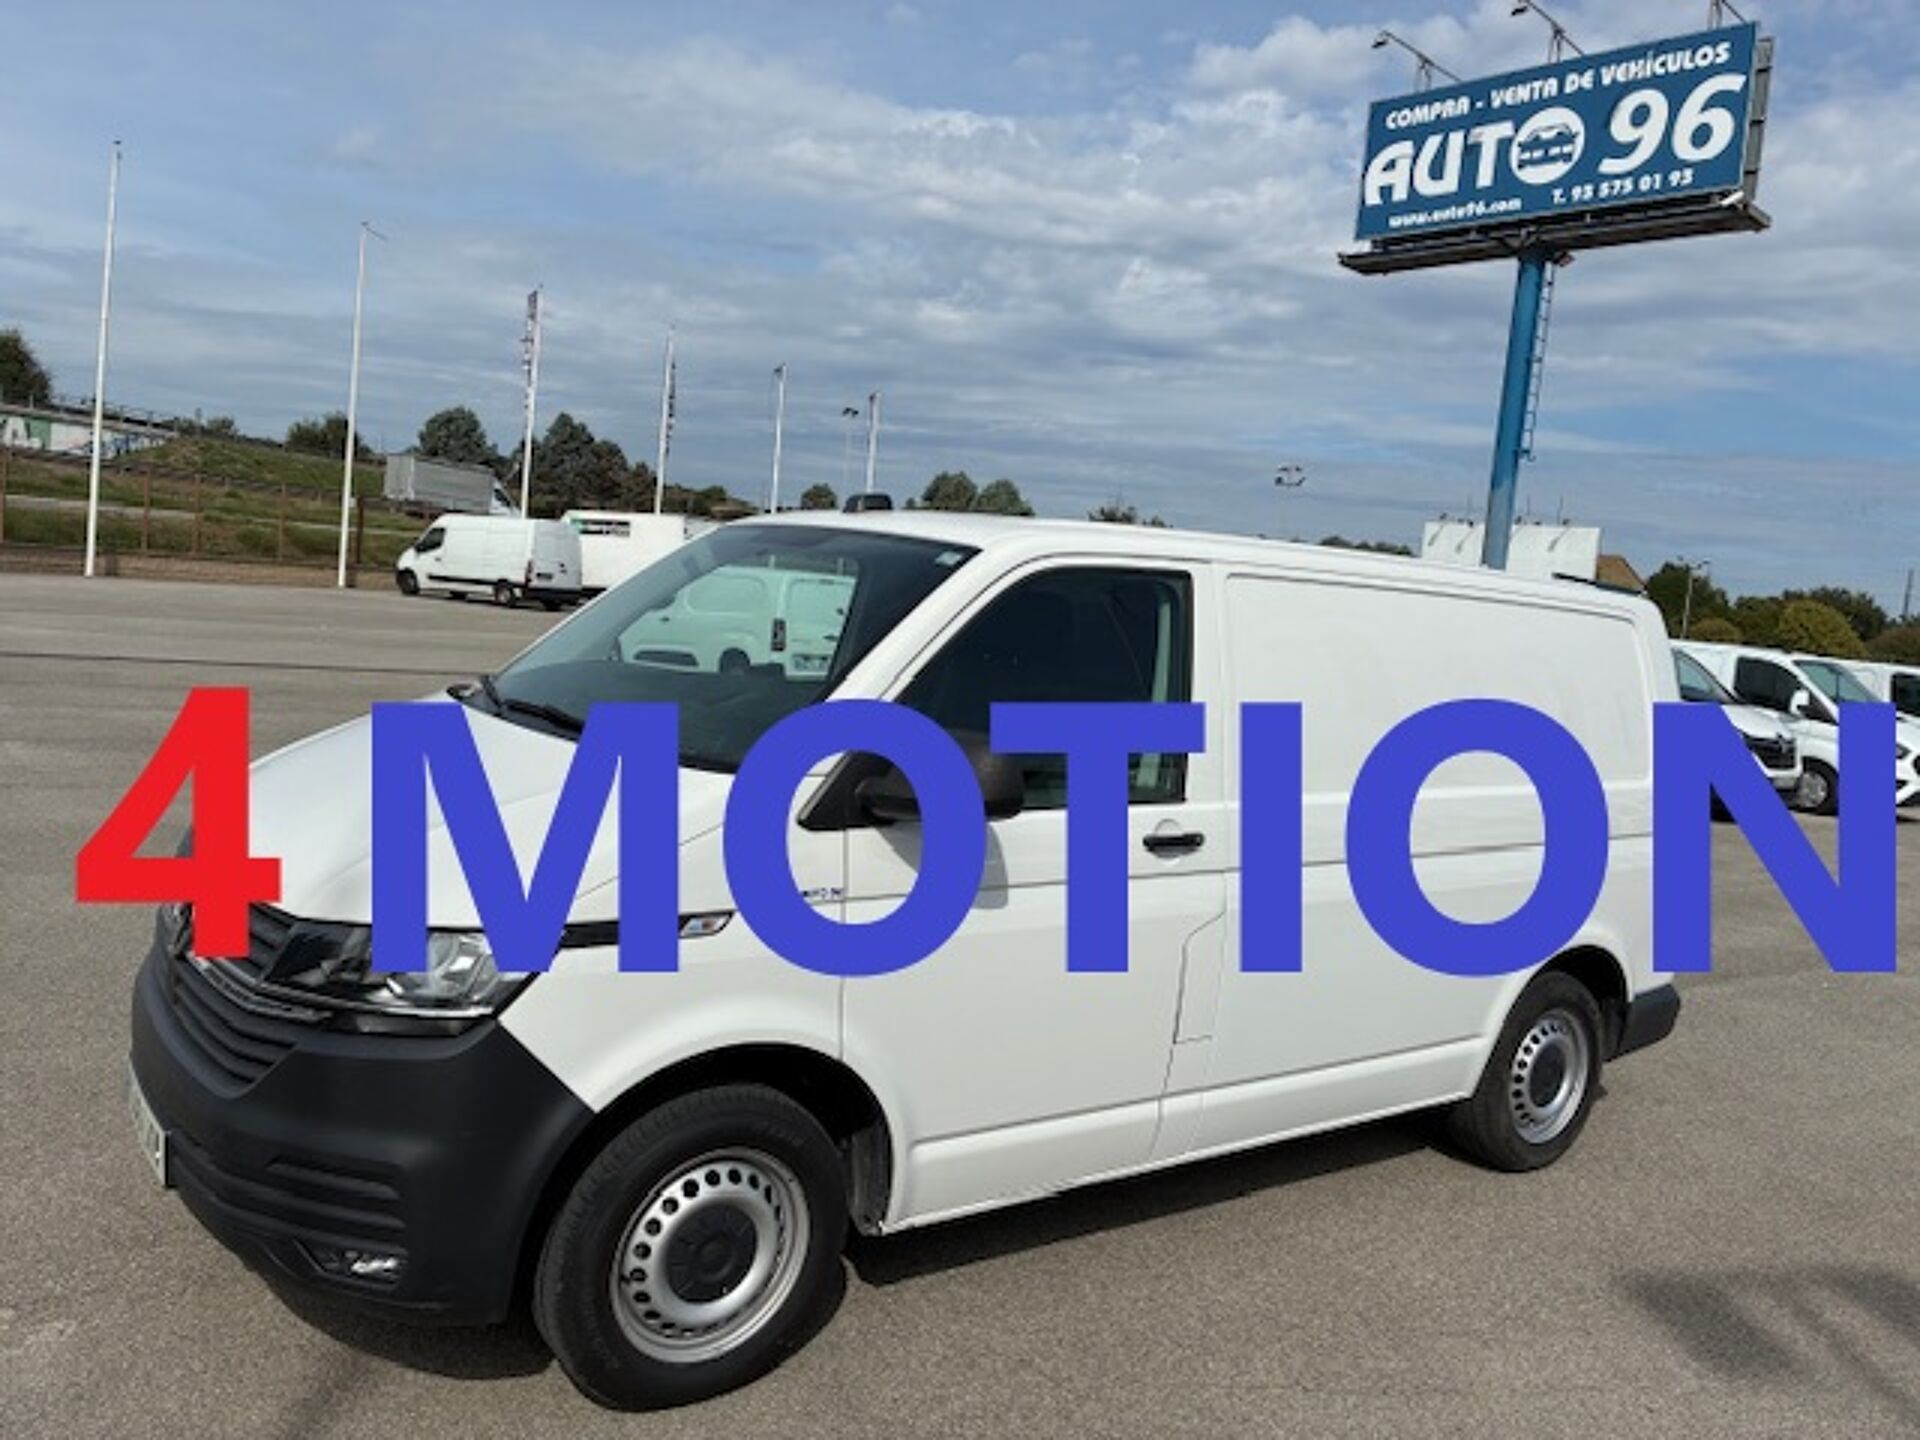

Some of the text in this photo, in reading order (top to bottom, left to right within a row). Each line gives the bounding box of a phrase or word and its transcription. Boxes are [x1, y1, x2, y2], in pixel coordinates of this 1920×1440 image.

[1385, 96, 1470, 129] COMPRA
[1490, 78, 1558, 108] VENTA
[1564, 69, 1595, 94] DE
[1364, 73, 1747, 205] AUTO 96
[1638, 173, 1662, 192] 01
